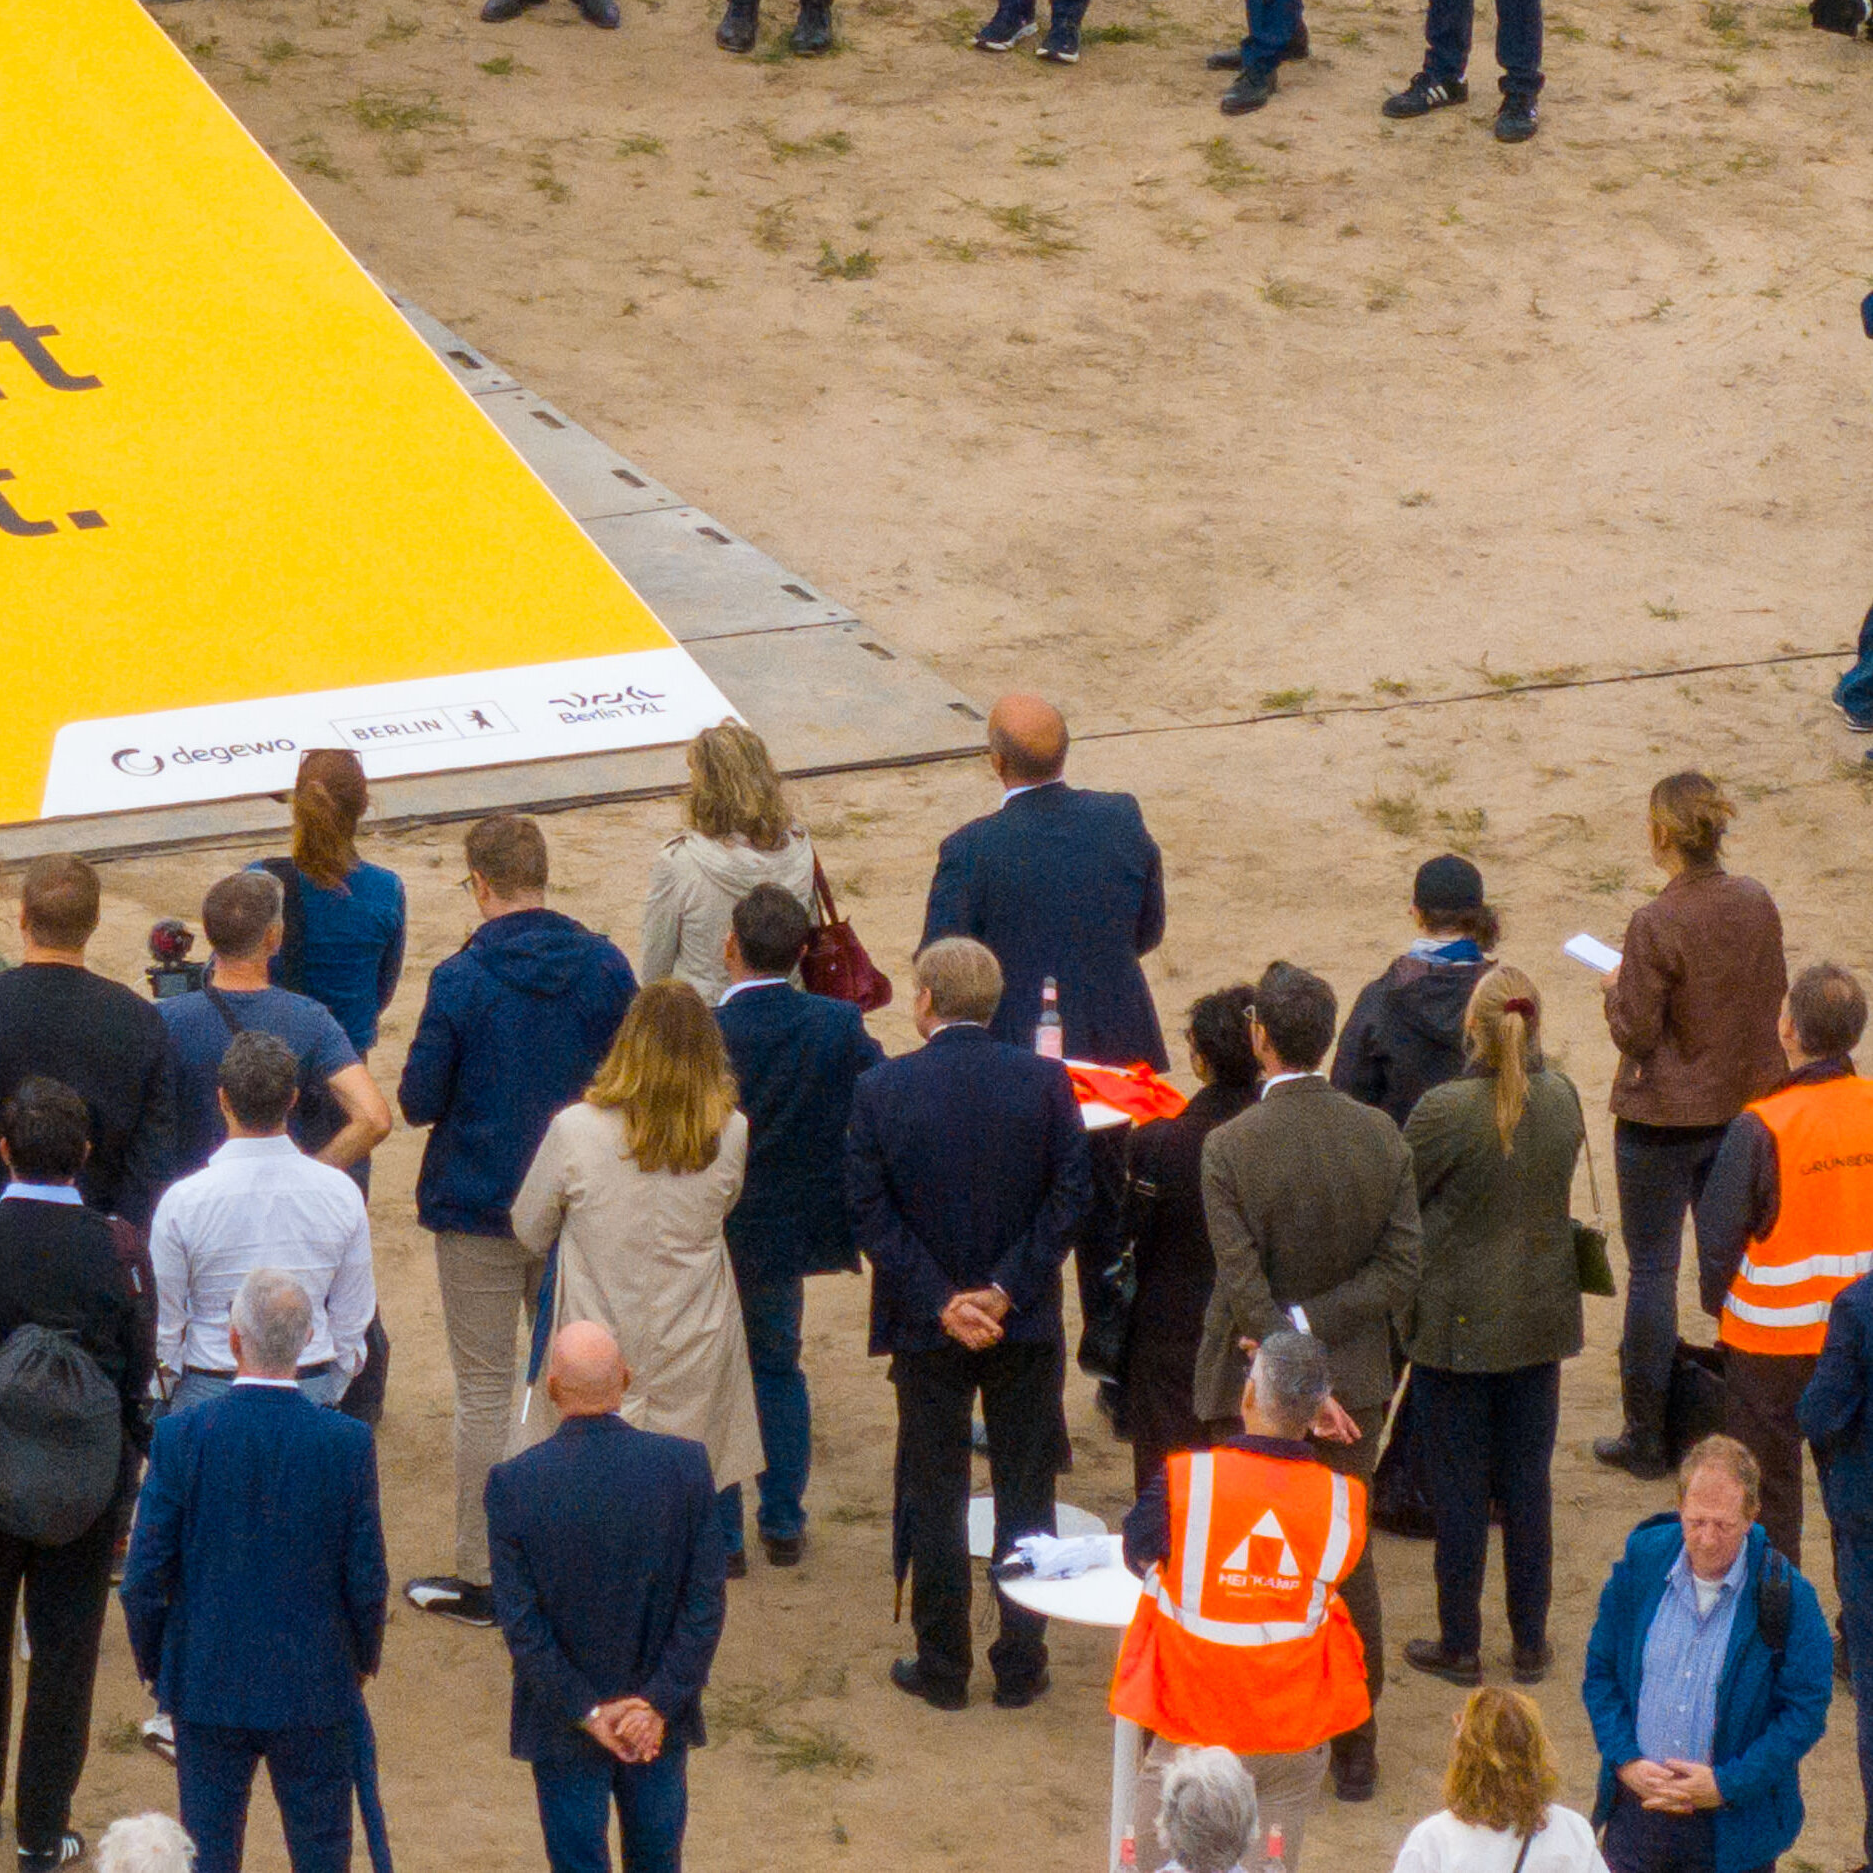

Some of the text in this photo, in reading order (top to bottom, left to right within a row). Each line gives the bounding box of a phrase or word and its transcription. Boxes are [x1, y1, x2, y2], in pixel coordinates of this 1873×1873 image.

[557, 703, 666, 724] Berlin TXL
[351, 719, 443, 741] BERLIN
[172, 739, 296, 765] degewo
